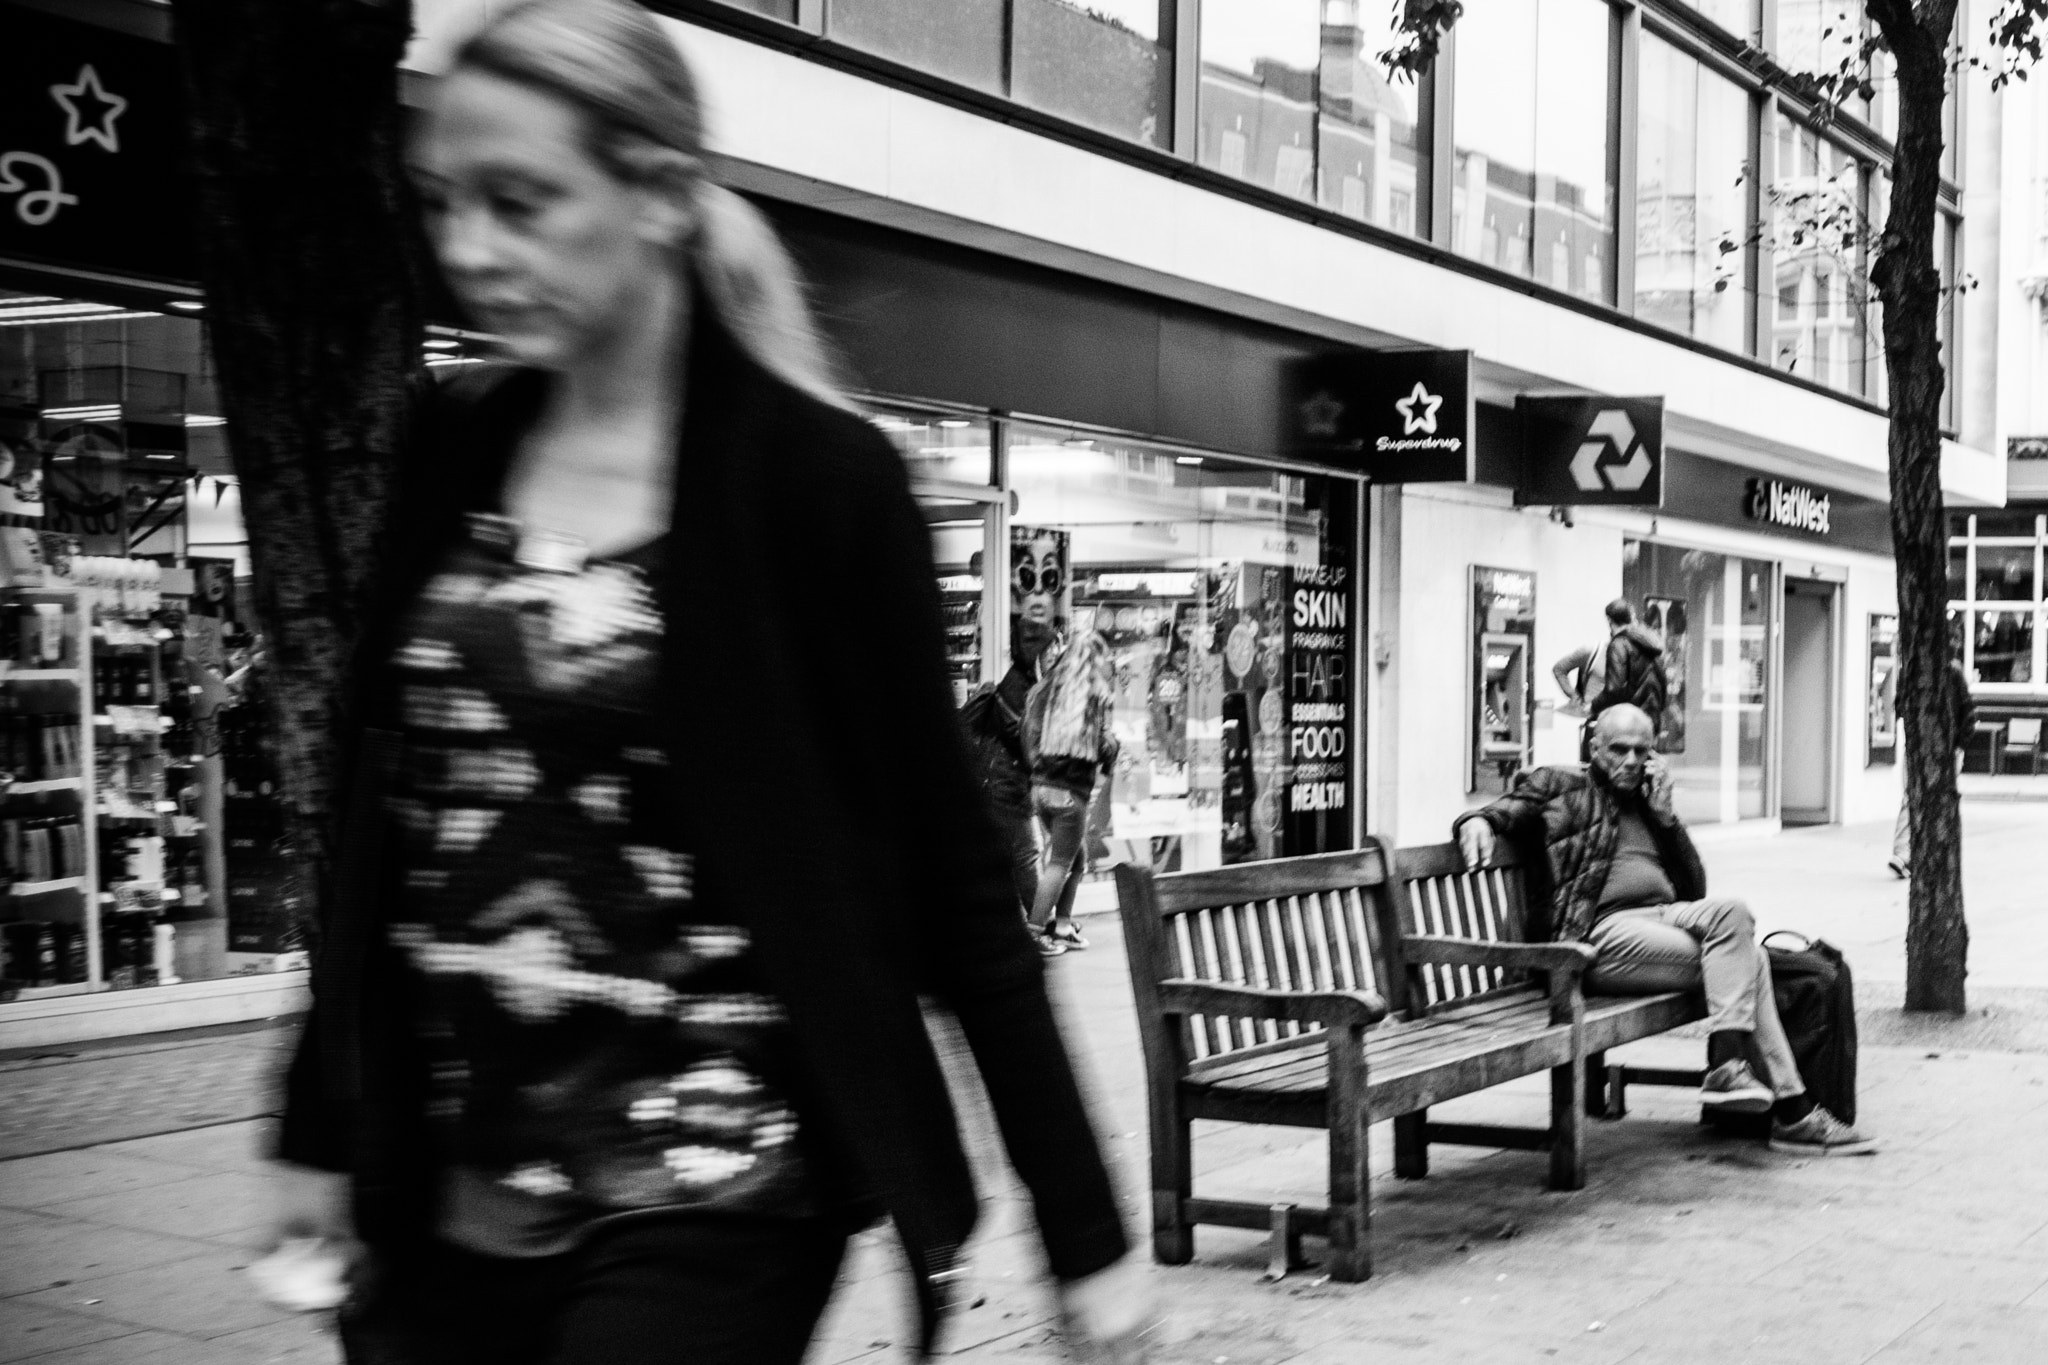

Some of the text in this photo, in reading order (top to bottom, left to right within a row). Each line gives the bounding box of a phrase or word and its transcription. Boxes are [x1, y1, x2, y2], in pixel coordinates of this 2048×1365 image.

[1375, 436, 1462, 452] Superdrug
[1769, 480, 1830, 534] NatWest
[1293, 588, 1347, 628] SKIN
[1291, 726, 1346, 759] FOOD
[1291, 781, 1346, 812] HEALTH
